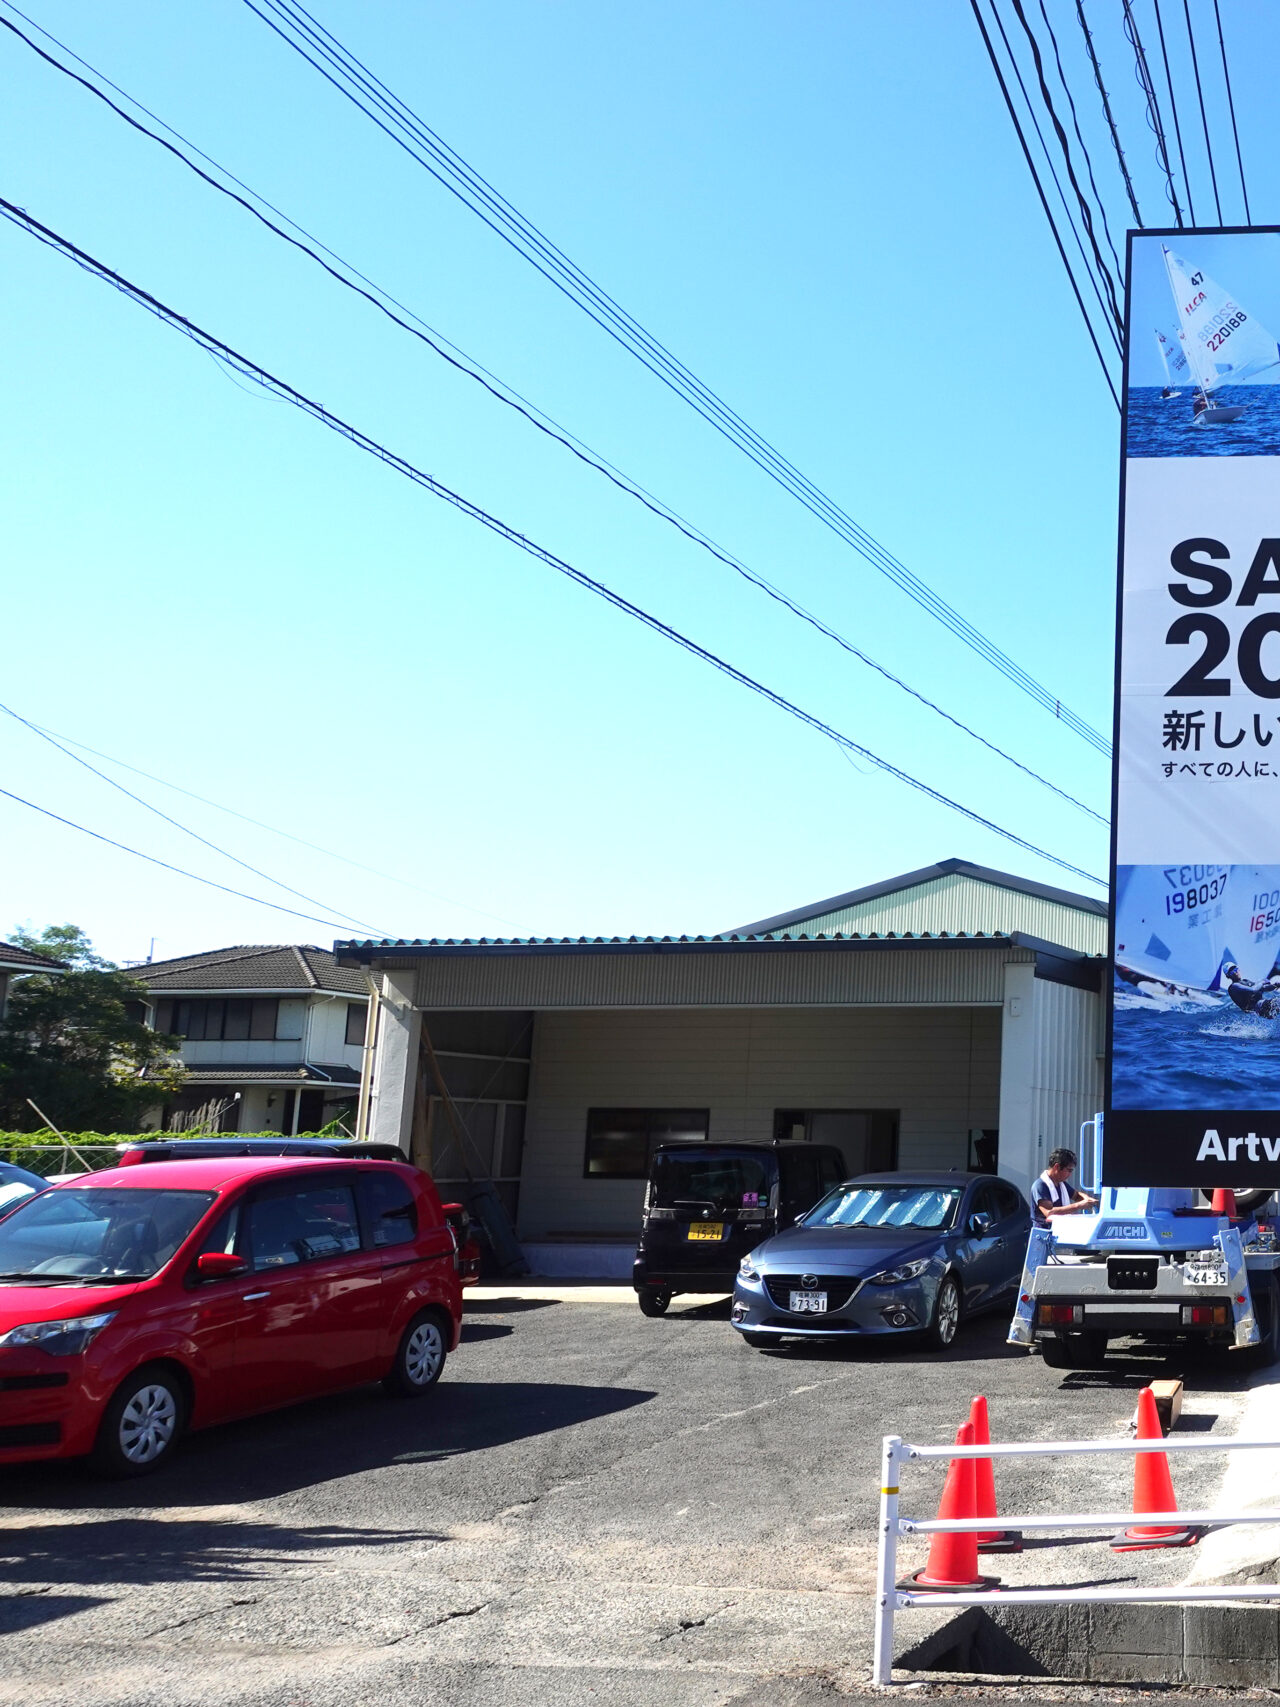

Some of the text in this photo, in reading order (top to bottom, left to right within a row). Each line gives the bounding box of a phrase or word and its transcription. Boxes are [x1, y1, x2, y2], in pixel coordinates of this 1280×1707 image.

[1191, 271, 1204, 286] 47
[1185, 291, 1206, 313] ILCA
[1207, 311, 1248, 352] 220188
[1166, 873, 1228, 916] 198037
[1105, 1226, 1145, 1237] AICHI
[1193, 1271, 1226, 1285] 64-35
[797, 1299, 826, 1311] 73-91
